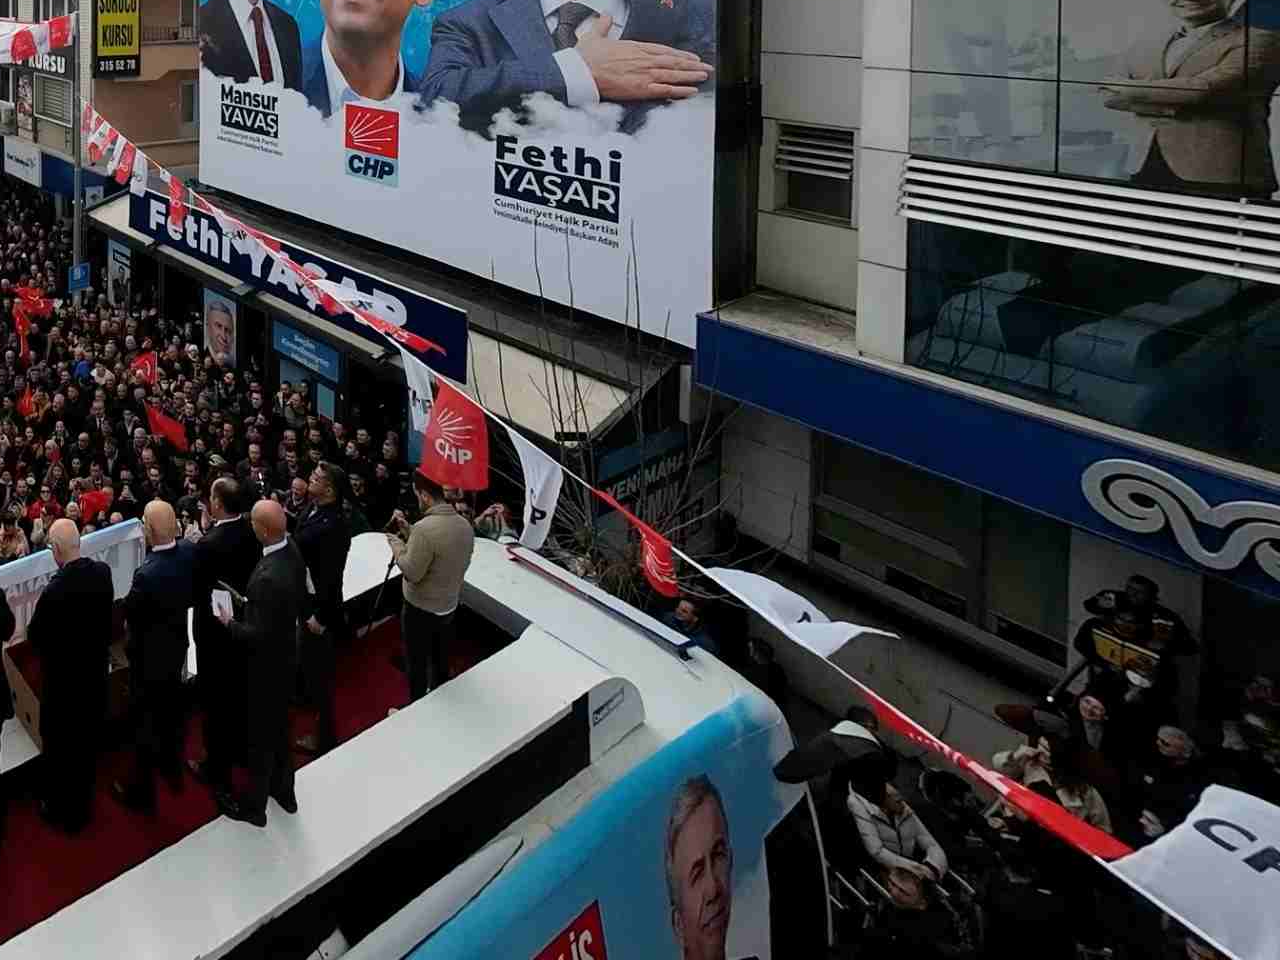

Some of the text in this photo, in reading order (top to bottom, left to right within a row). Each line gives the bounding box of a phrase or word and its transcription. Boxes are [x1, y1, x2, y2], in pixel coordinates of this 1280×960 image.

[102, 24, 134, 48] KURSU
[28, 53, 66, 74] KURSU
[221, 84, 278, 112] Mansur
[222, 105, 278, 136] YAVAŞ
[348, 154, 394, 179] CHP
[496, 134, 622, 184] Fethi
[497, 164, 616, 214] YAŞAR
[494, 198, 619, 236] Cumhuriyet Halk Partisi
[434, 438, 472, 465] CHP
